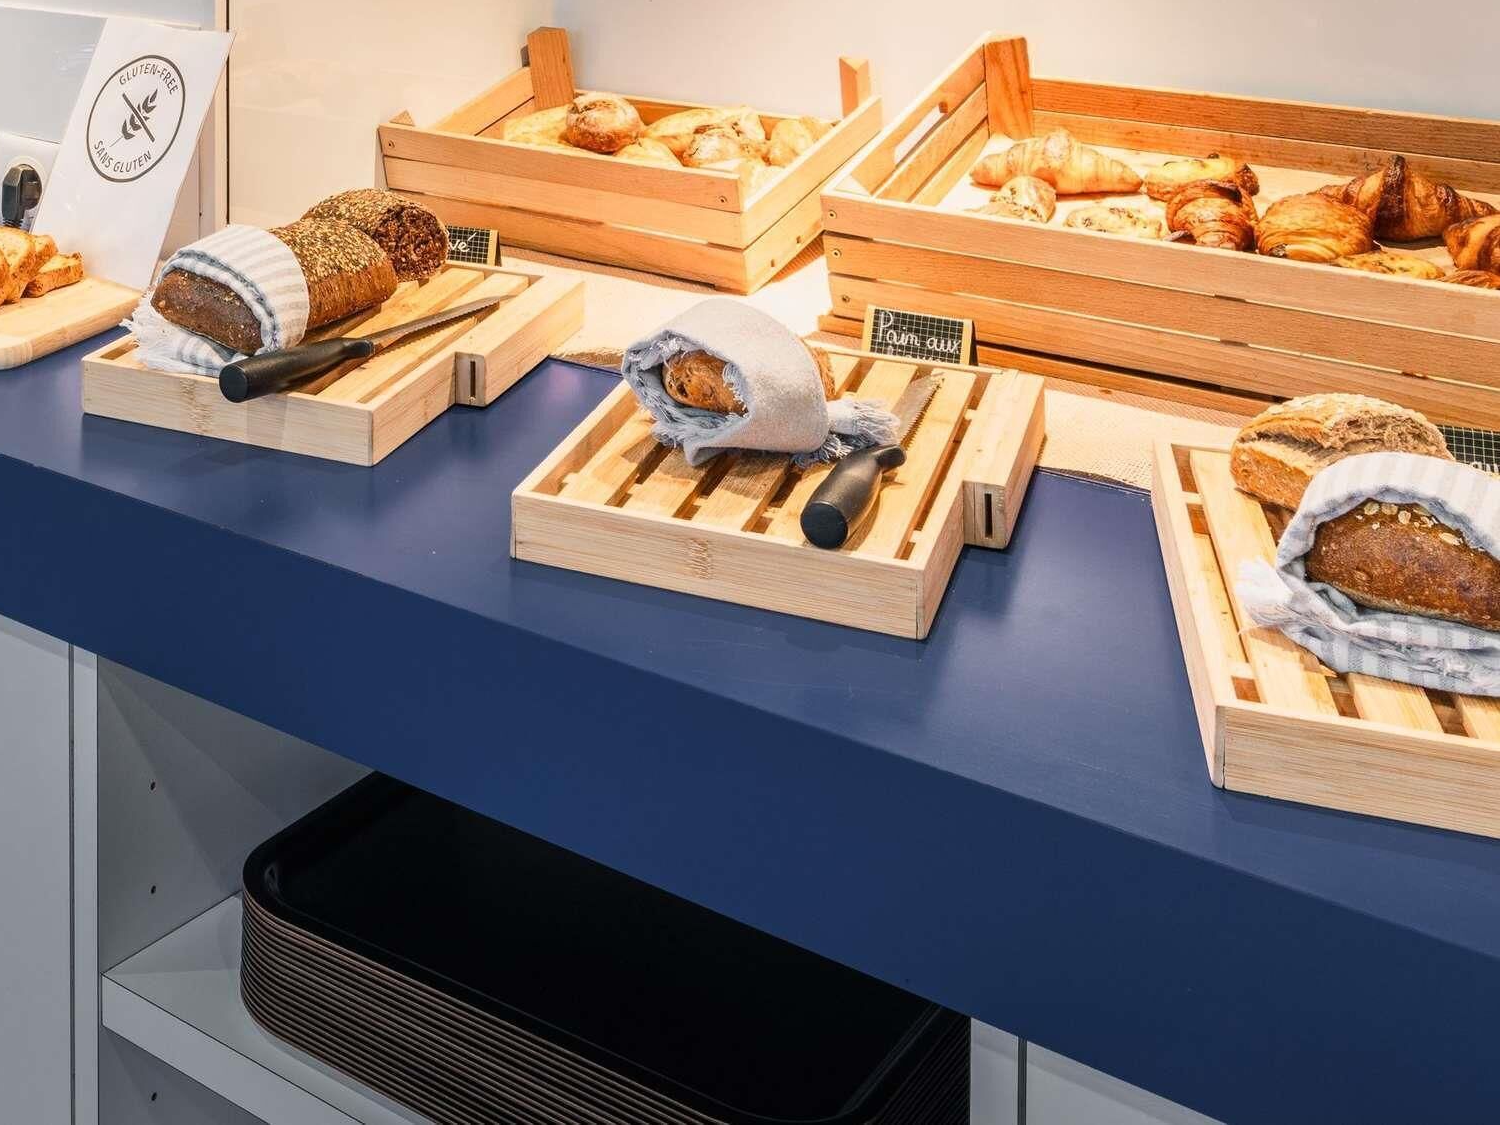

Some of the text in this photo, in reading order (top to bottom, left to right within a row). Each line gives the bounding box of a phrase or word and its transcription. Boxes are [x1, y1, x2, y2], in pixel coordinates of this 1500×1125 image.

[119, 62, 179, 95] GLUTEN-FREE
[94, 140, 152, 173] SANS GLUTEN
[879, 311, 961, 353] Pain aux
